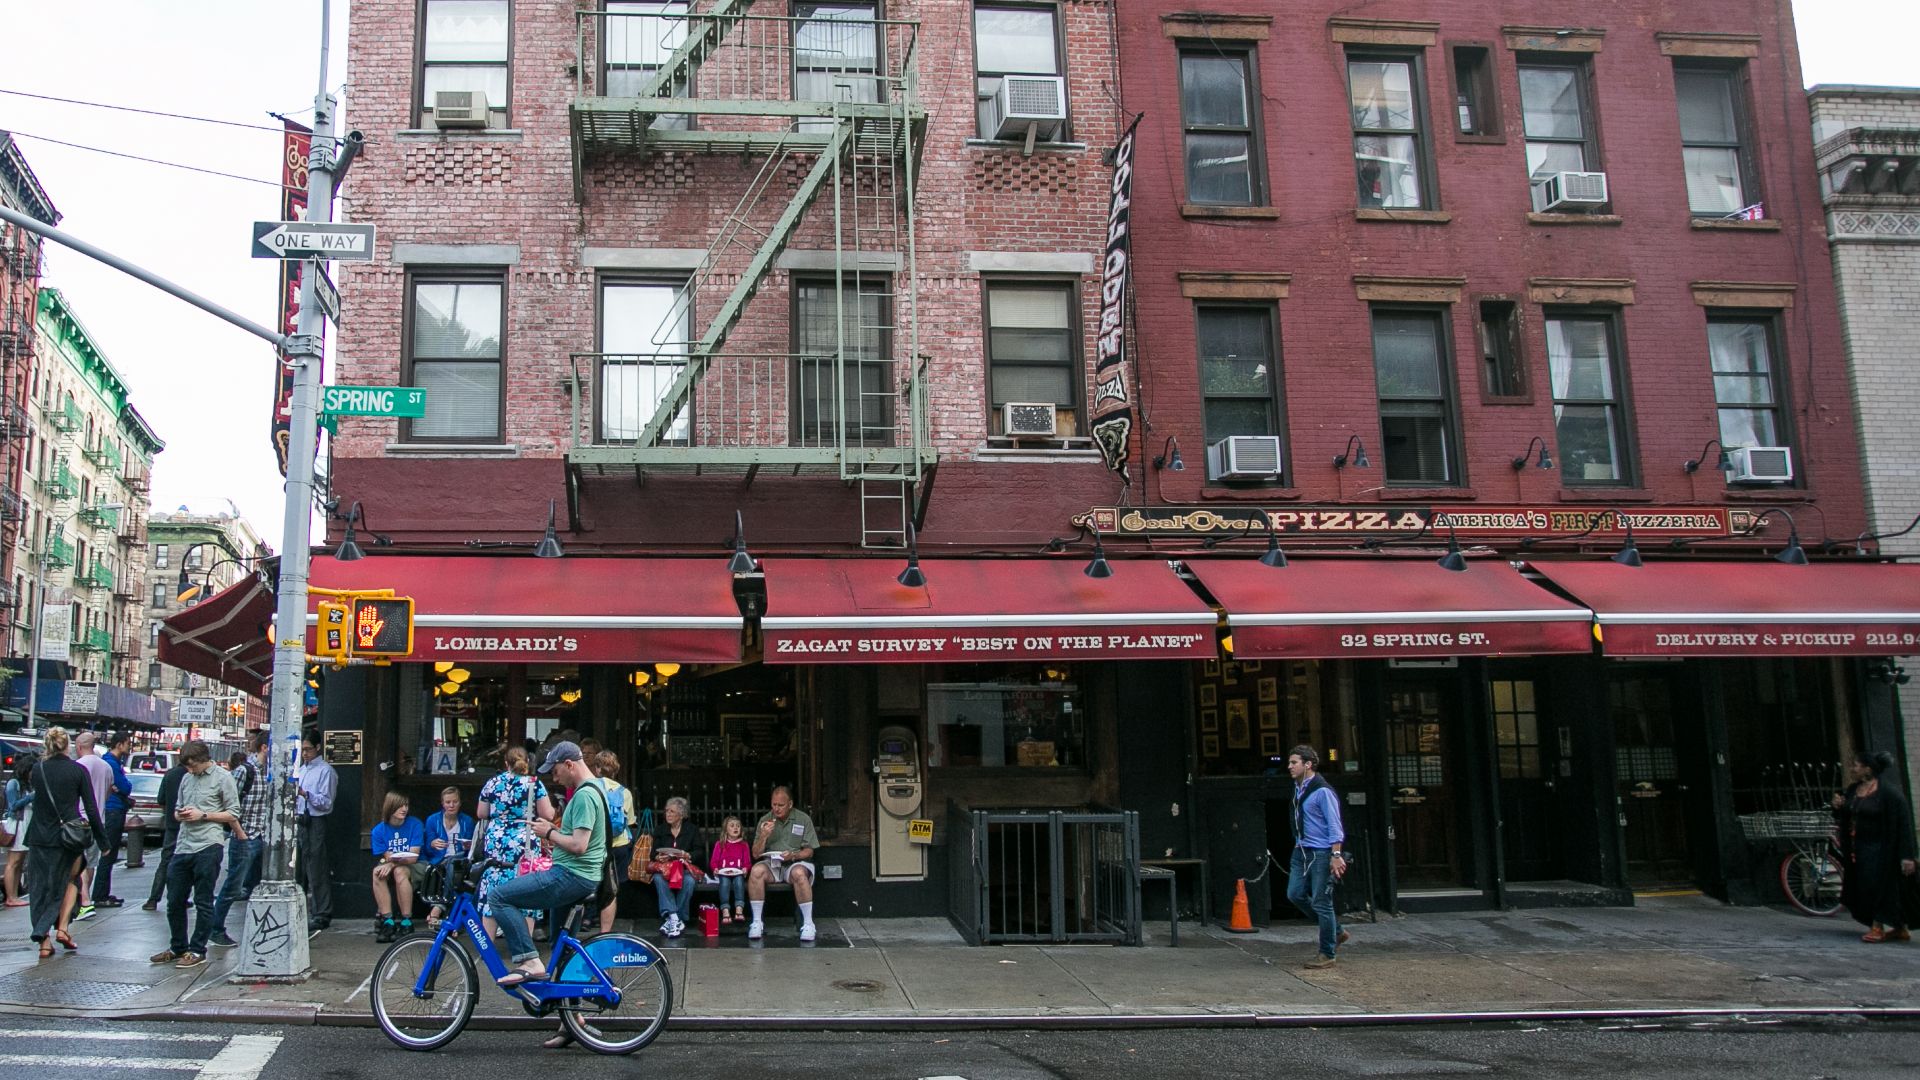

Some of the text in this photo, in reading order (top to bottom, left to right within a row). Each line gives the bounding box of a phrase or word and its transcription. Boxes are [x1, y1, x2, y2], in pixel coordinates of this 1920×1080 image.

[275, 233, 357, 249] ONE WAY
[325, 389, 421, 412] SPRING ST
[1121, 510, 1721, 531] Coal Oven PIZZA AMERICA'S FIRST PIZZERIA
[434, 635, 578, 651] LOMBARDI'S
[776, 639, 852, 653] ZAGAT
[857, 638, 947, 652] SURVEY
[1023, 637, 1053, 650] ON
[1058, 636, 1103, 650] THE
[1341, 632, 1490, 647] 32 SPRING ST.
[1656, 633, 1759, 646] DELIVERY
[1763, 633, 1777, 646] &
[1780, 633, 1856, 646] PICKUP
[437, 753, 452, 771] A
[912, 823, 931, 832] ATM
[388, 838, 408, 847] KEEP
